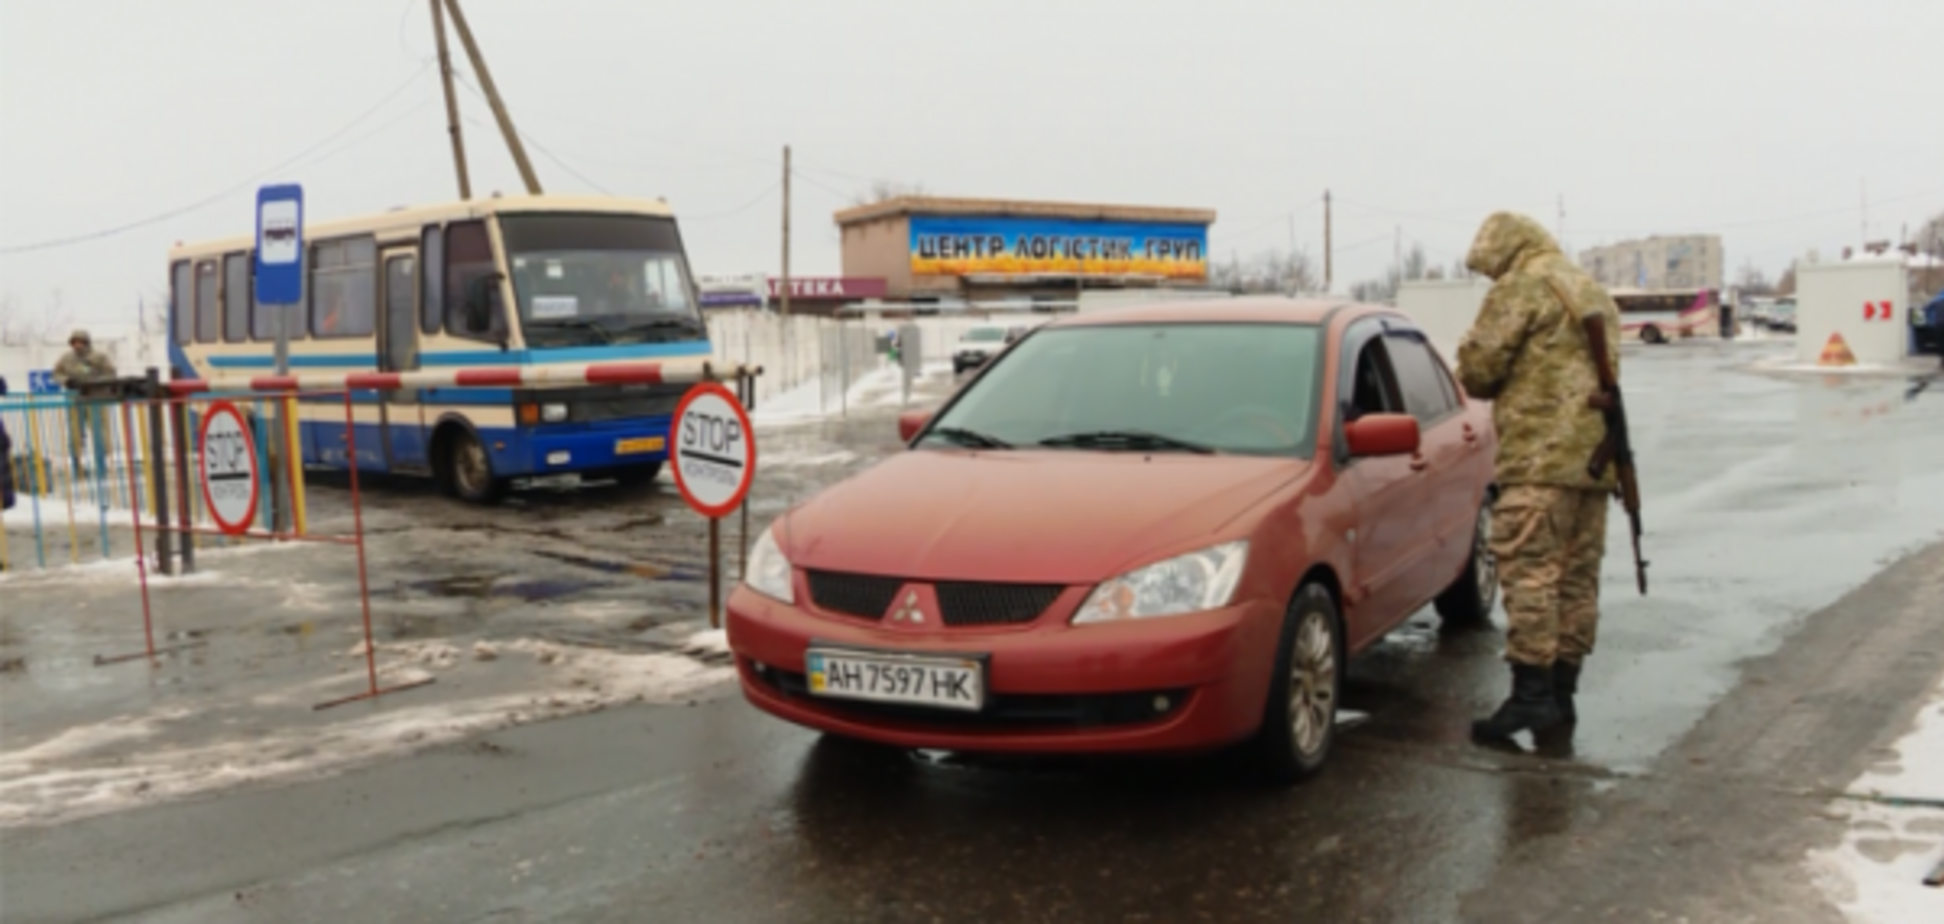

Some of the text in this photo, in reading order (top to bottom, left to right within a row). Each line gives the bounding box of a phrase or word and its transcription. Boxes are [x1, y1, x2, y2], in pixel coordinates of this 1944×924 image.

[918, 234, 1200, 261] ЦЕНТР ЛОГІСТИК ГРУП
[206, 431, 245, 472] STOP
[684, 410, 740, 454] STOP
[828, 660, 971, 701] AH 7597 HK
